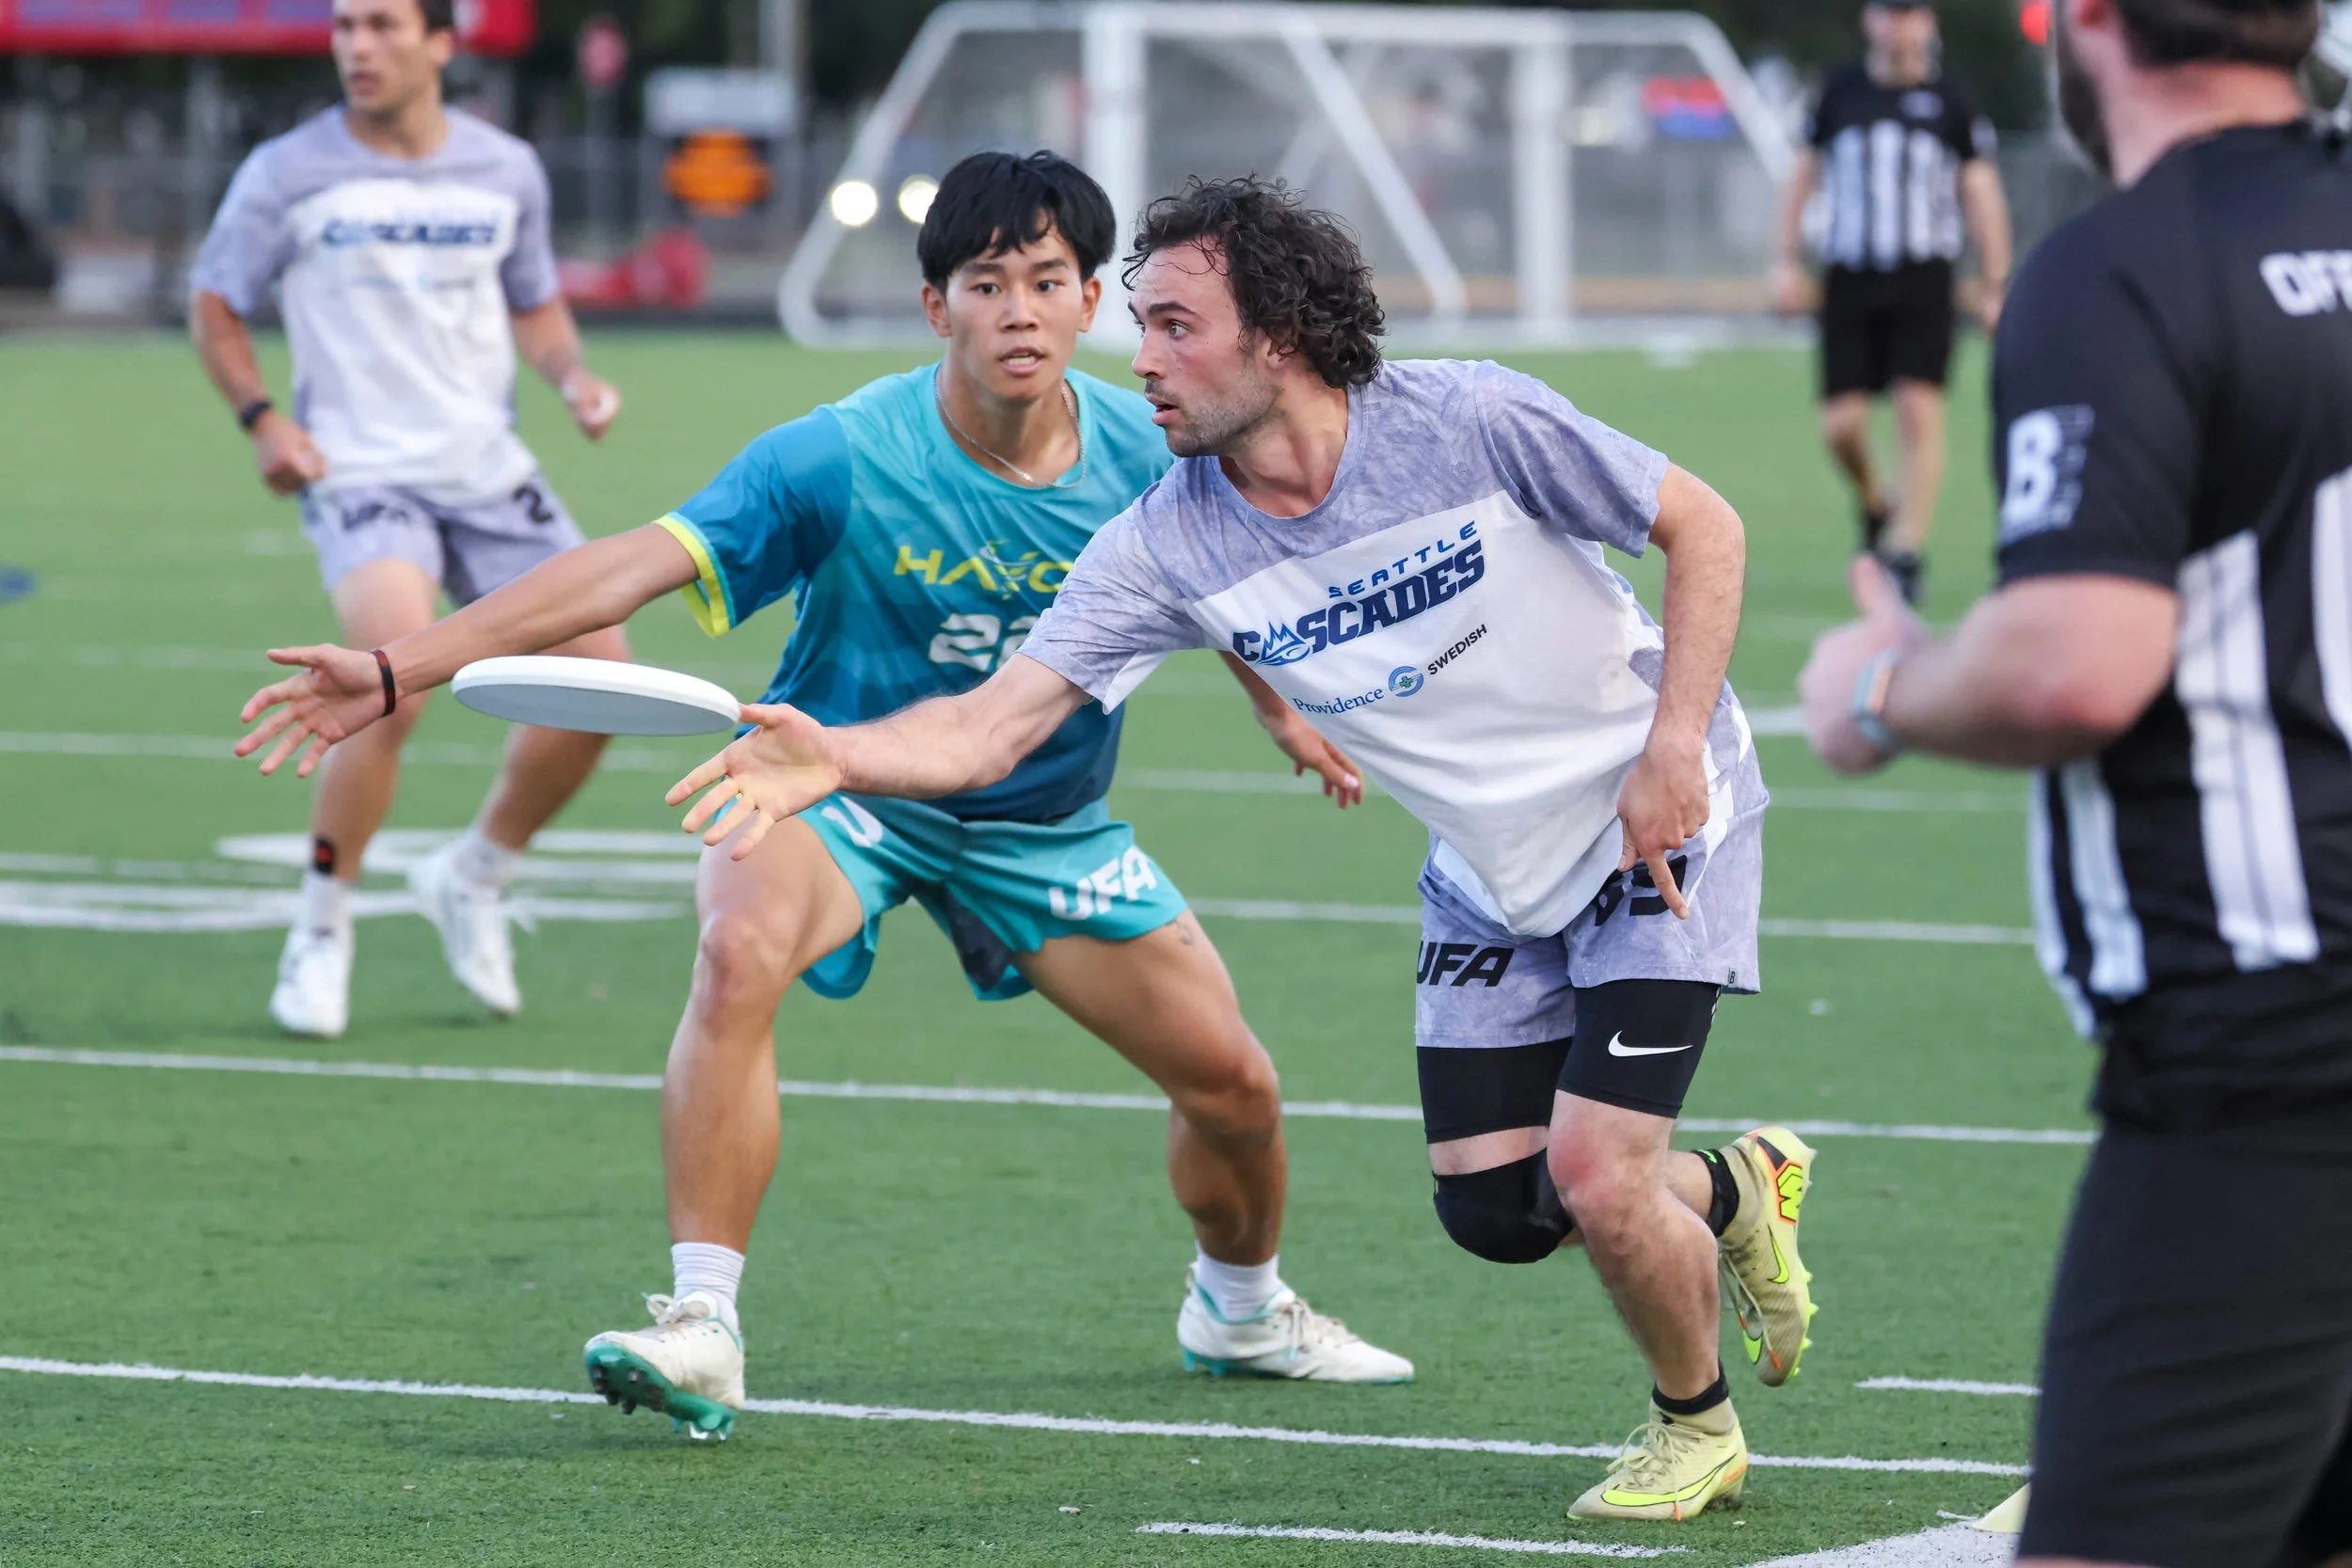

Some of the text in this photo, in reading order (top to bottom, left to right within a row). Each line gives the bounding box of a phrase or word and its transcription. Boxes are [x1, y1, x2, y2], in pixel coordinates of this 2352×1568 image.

[1328, 520, 1478, 599] SEATTLE
[1294, 624, 1487, 716] Providence SWEDISH
[1048, 845, 1158, 921] UFA
[1416, 941, 1515, 988] UFA
